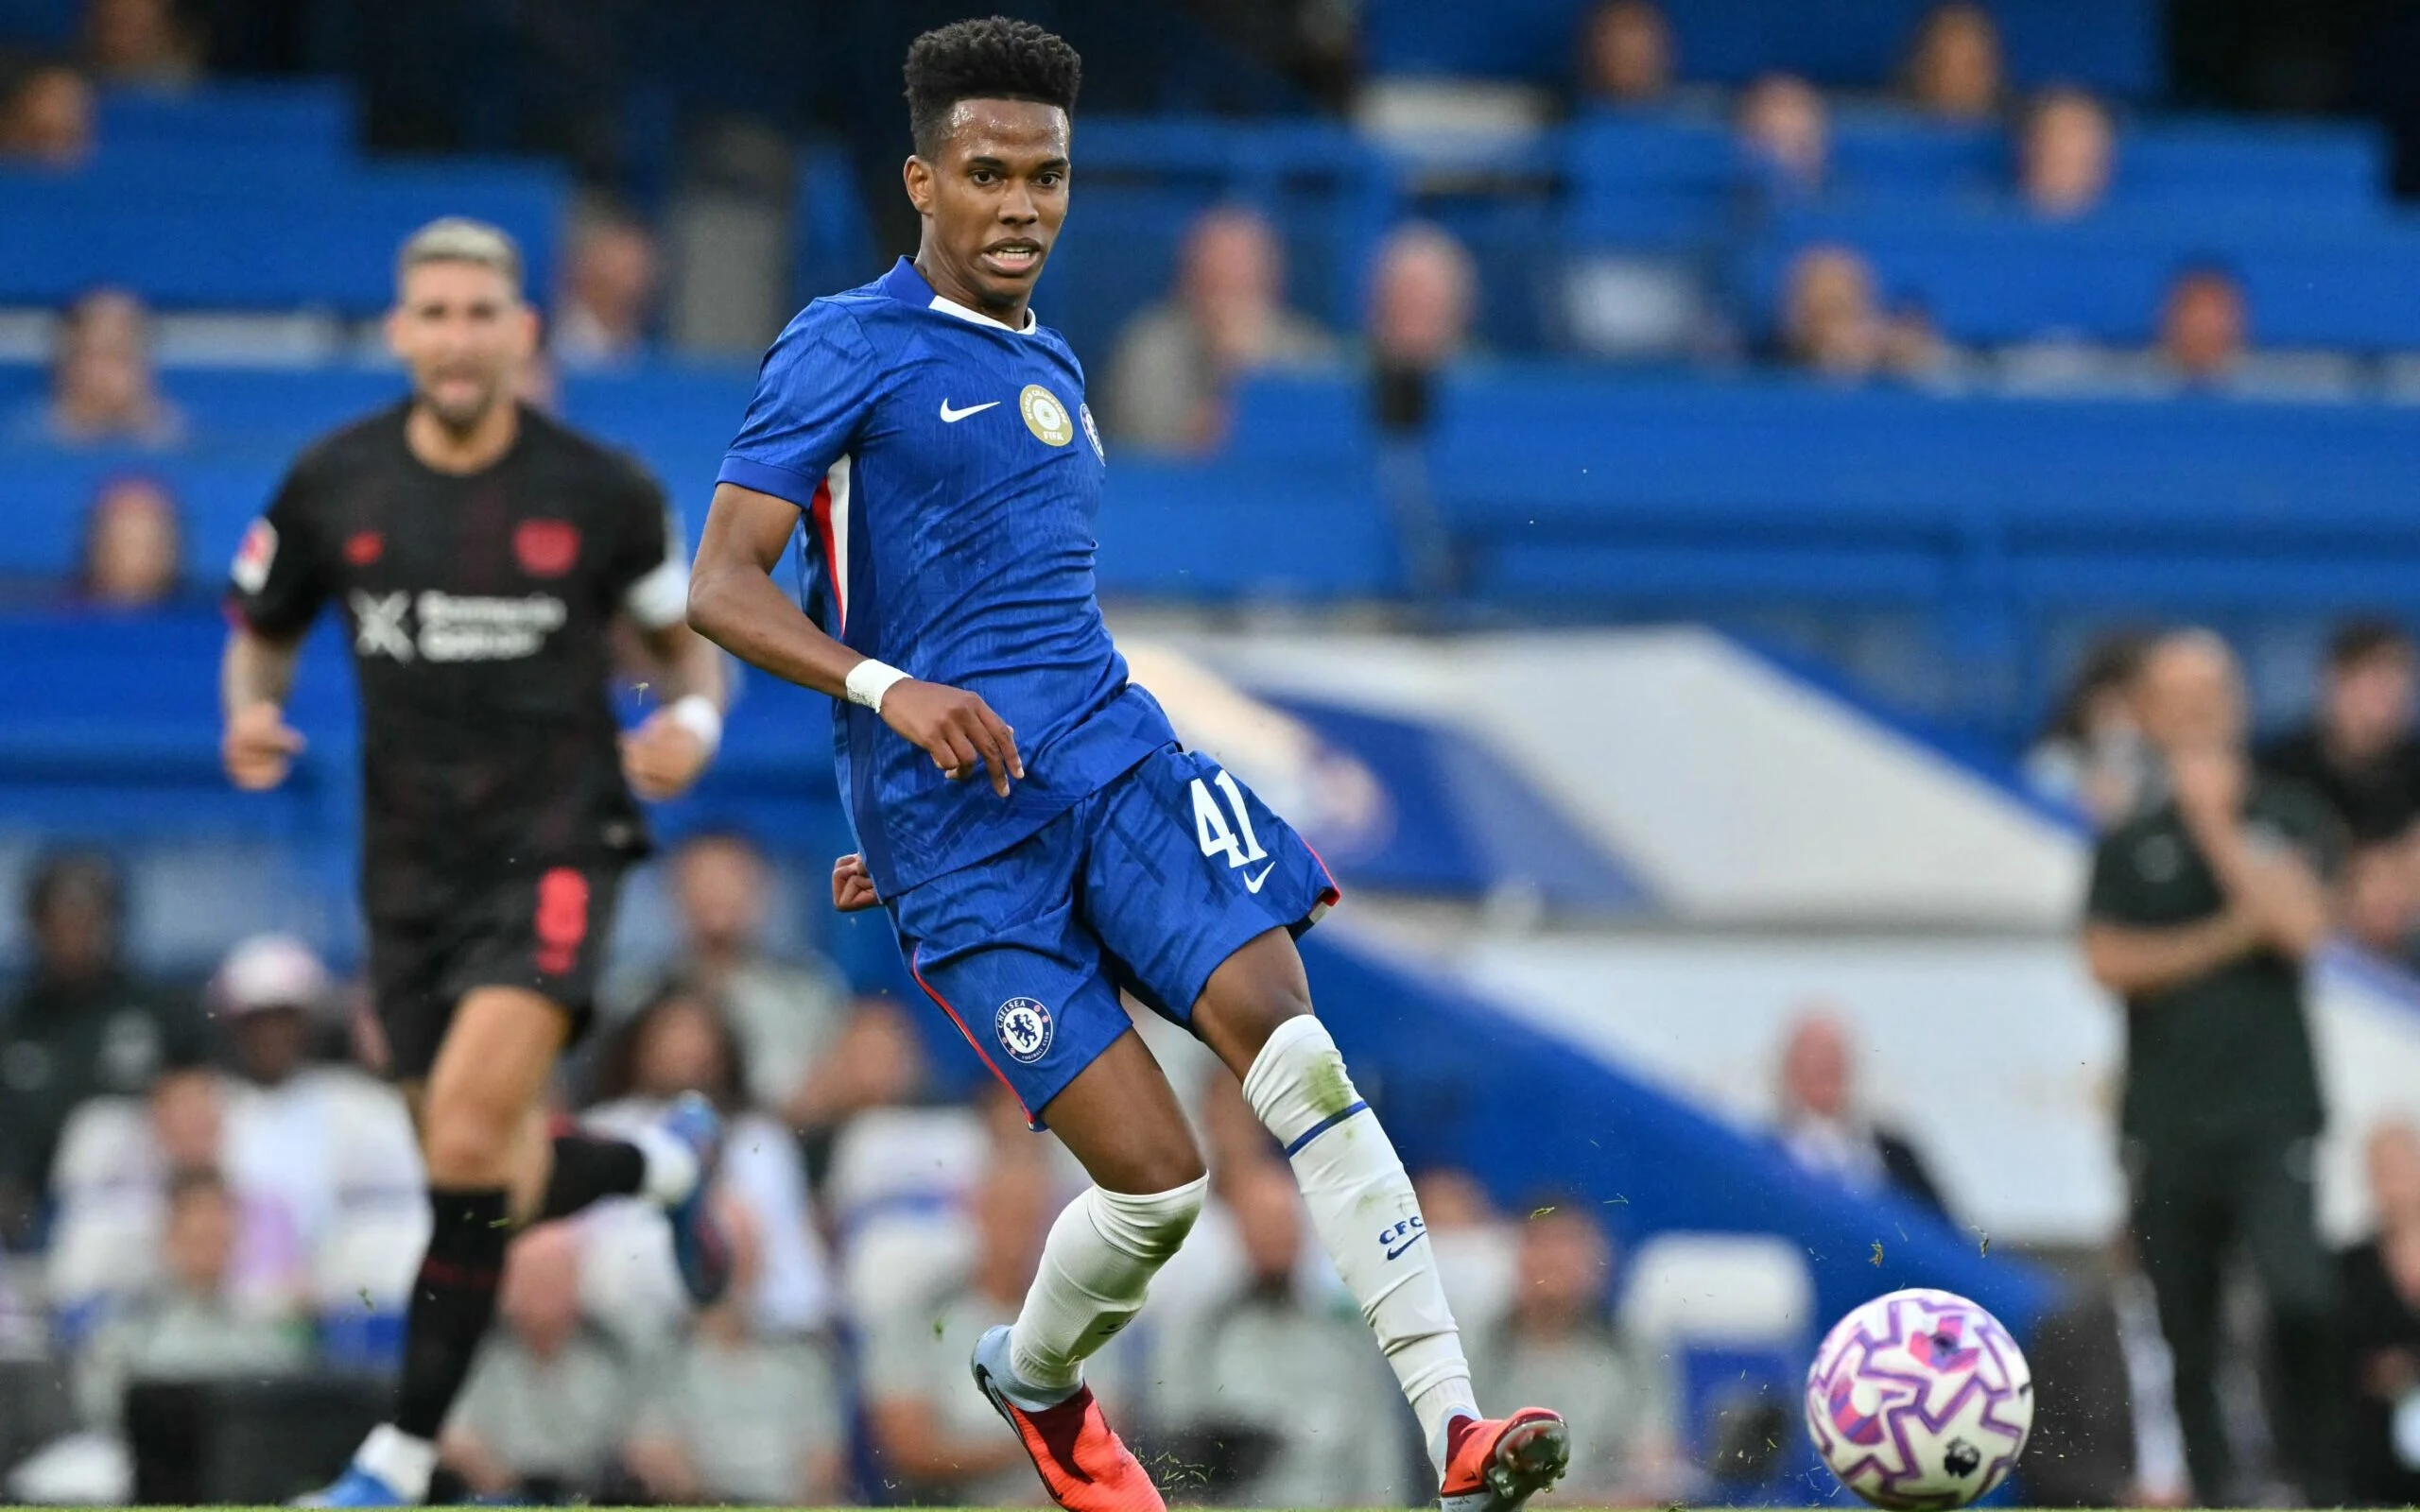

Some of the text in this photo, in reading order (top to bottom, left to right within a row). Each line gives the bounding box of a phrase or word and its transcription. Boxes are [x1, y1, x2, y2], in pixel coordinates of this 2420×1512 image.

[1043, 430, 1064, 441] FIFA
[1190, 768, 1268, 868] 41
[997, 1000, 1026, 1028] CHELSEA
[1379, 1216, 1424, 1245] CFC
